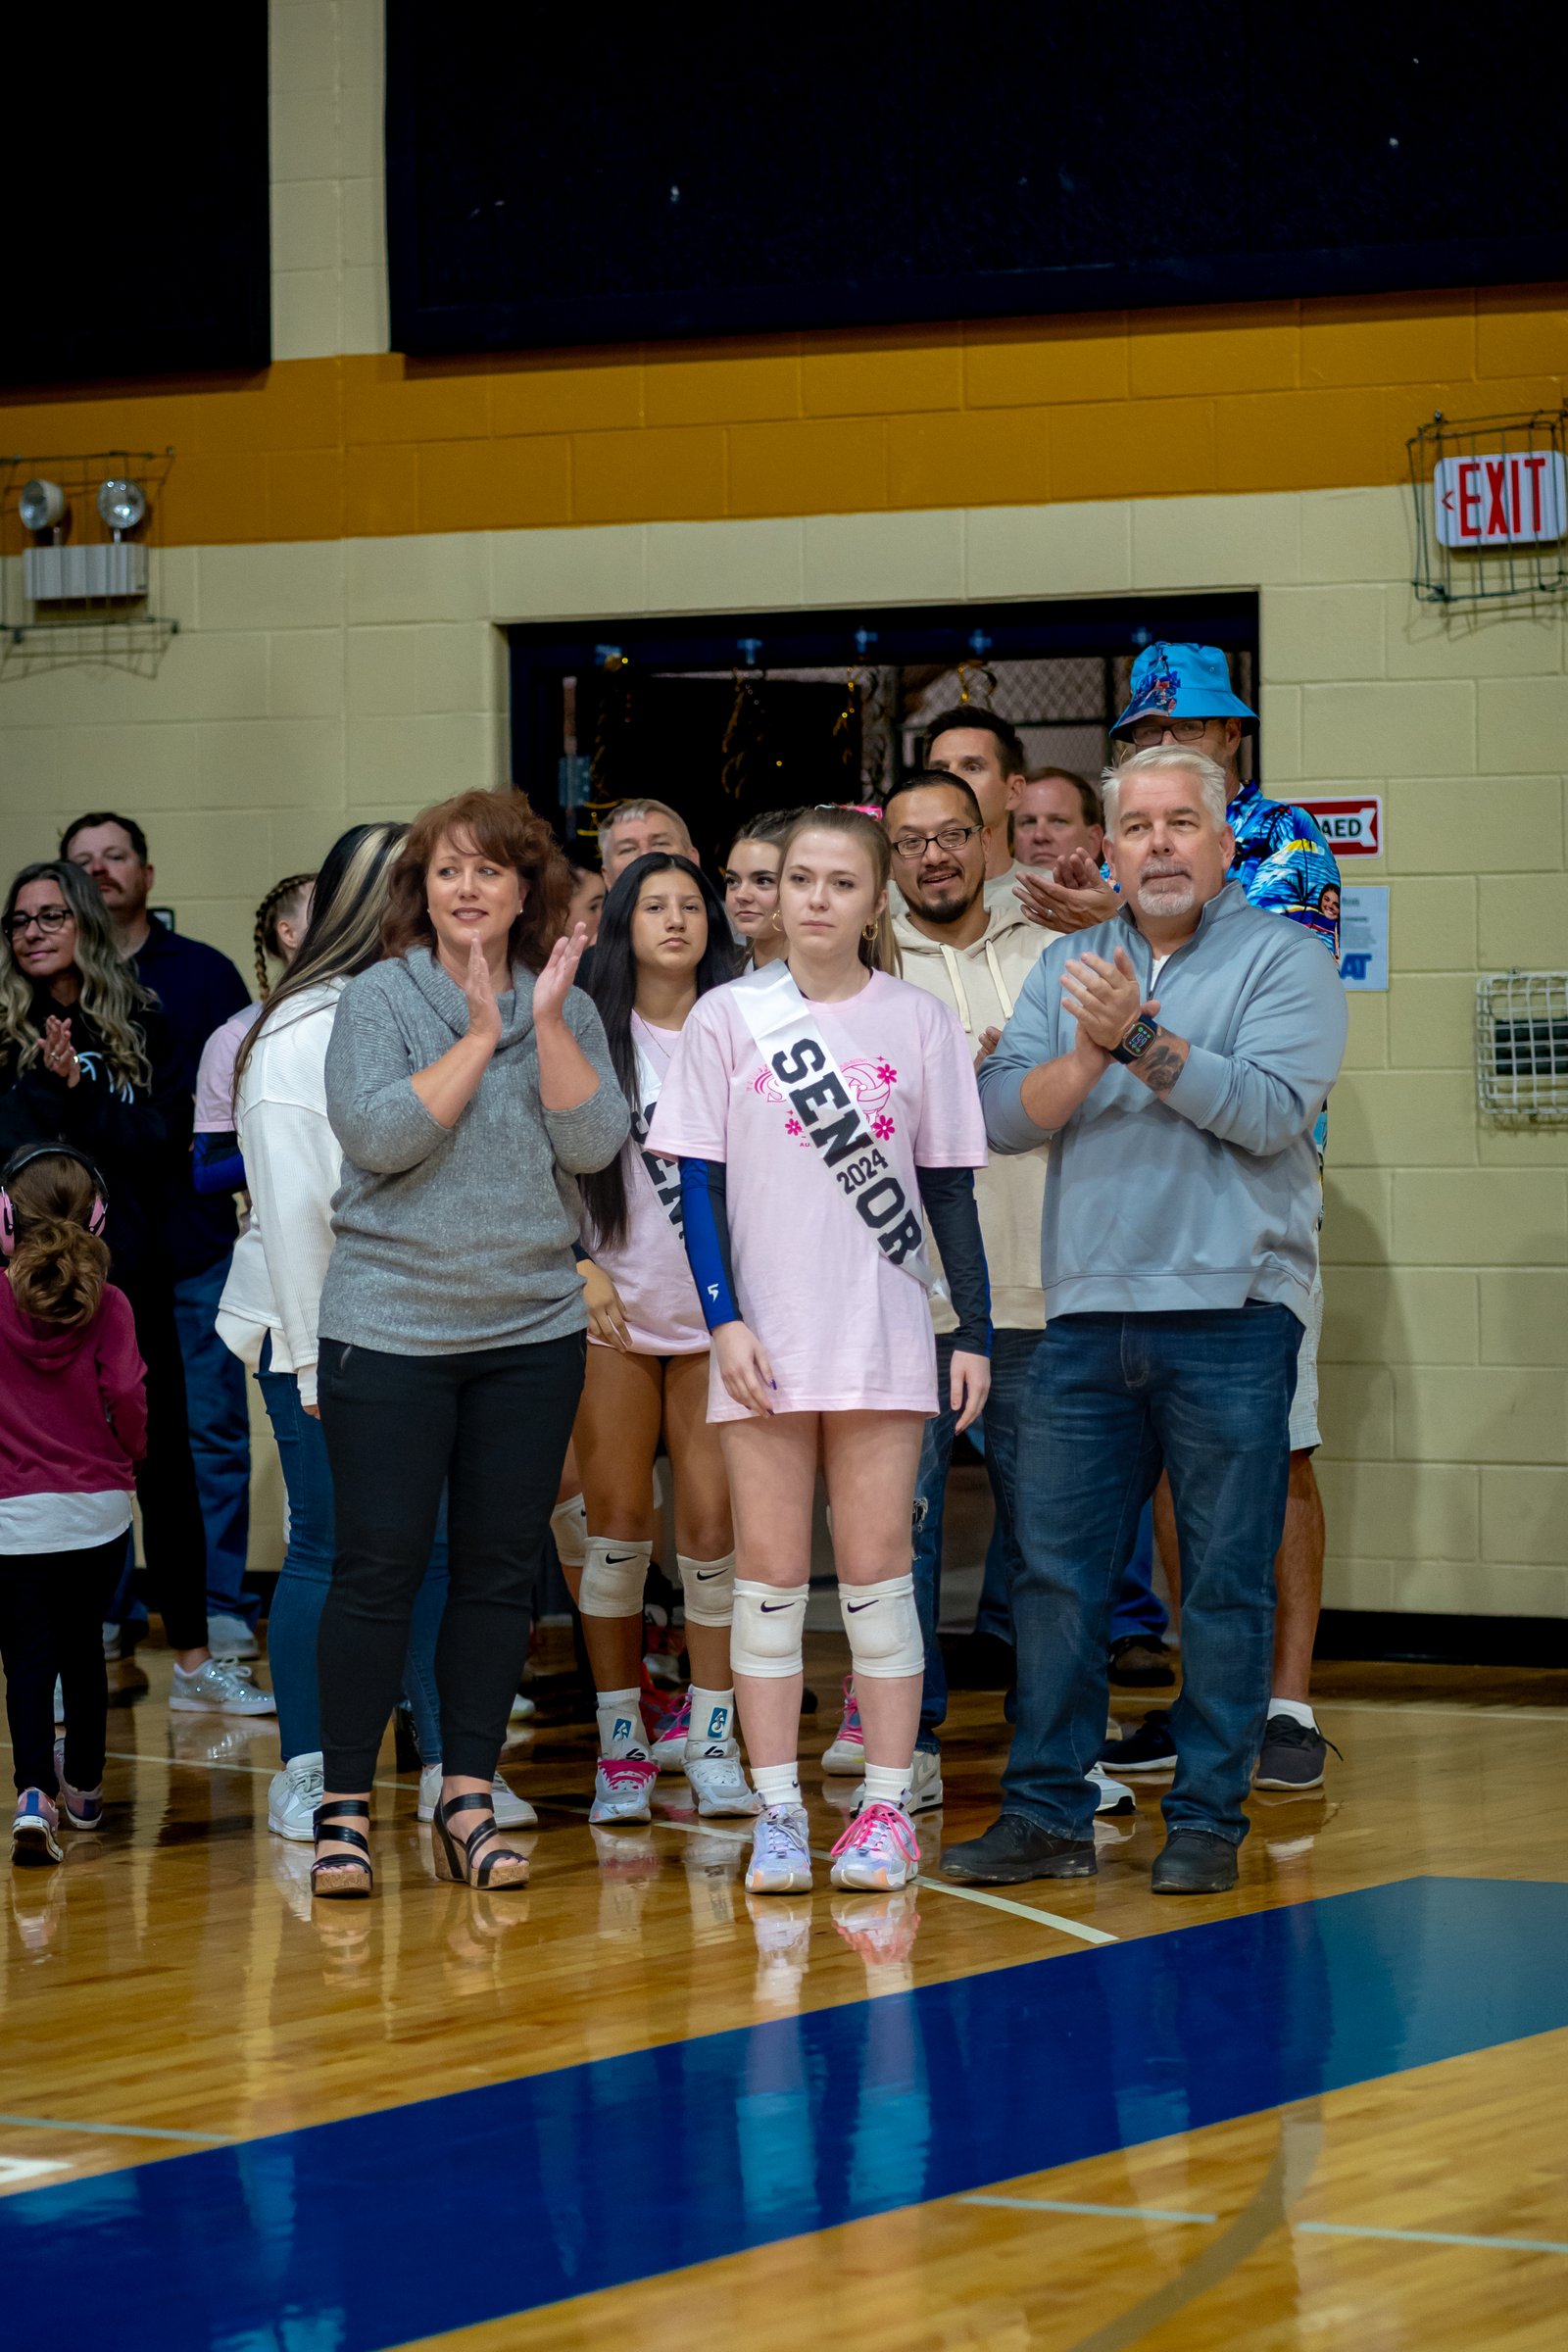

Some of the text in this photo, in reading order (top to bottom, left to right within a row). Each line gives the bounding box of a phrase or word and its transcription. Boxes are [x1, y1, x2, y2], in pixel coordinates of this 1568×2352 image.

[1458, 458, 1546, 537] EXIT
[1321, 817, 1362, 837] AED
[836, 1148, 890, 1195] 2024
